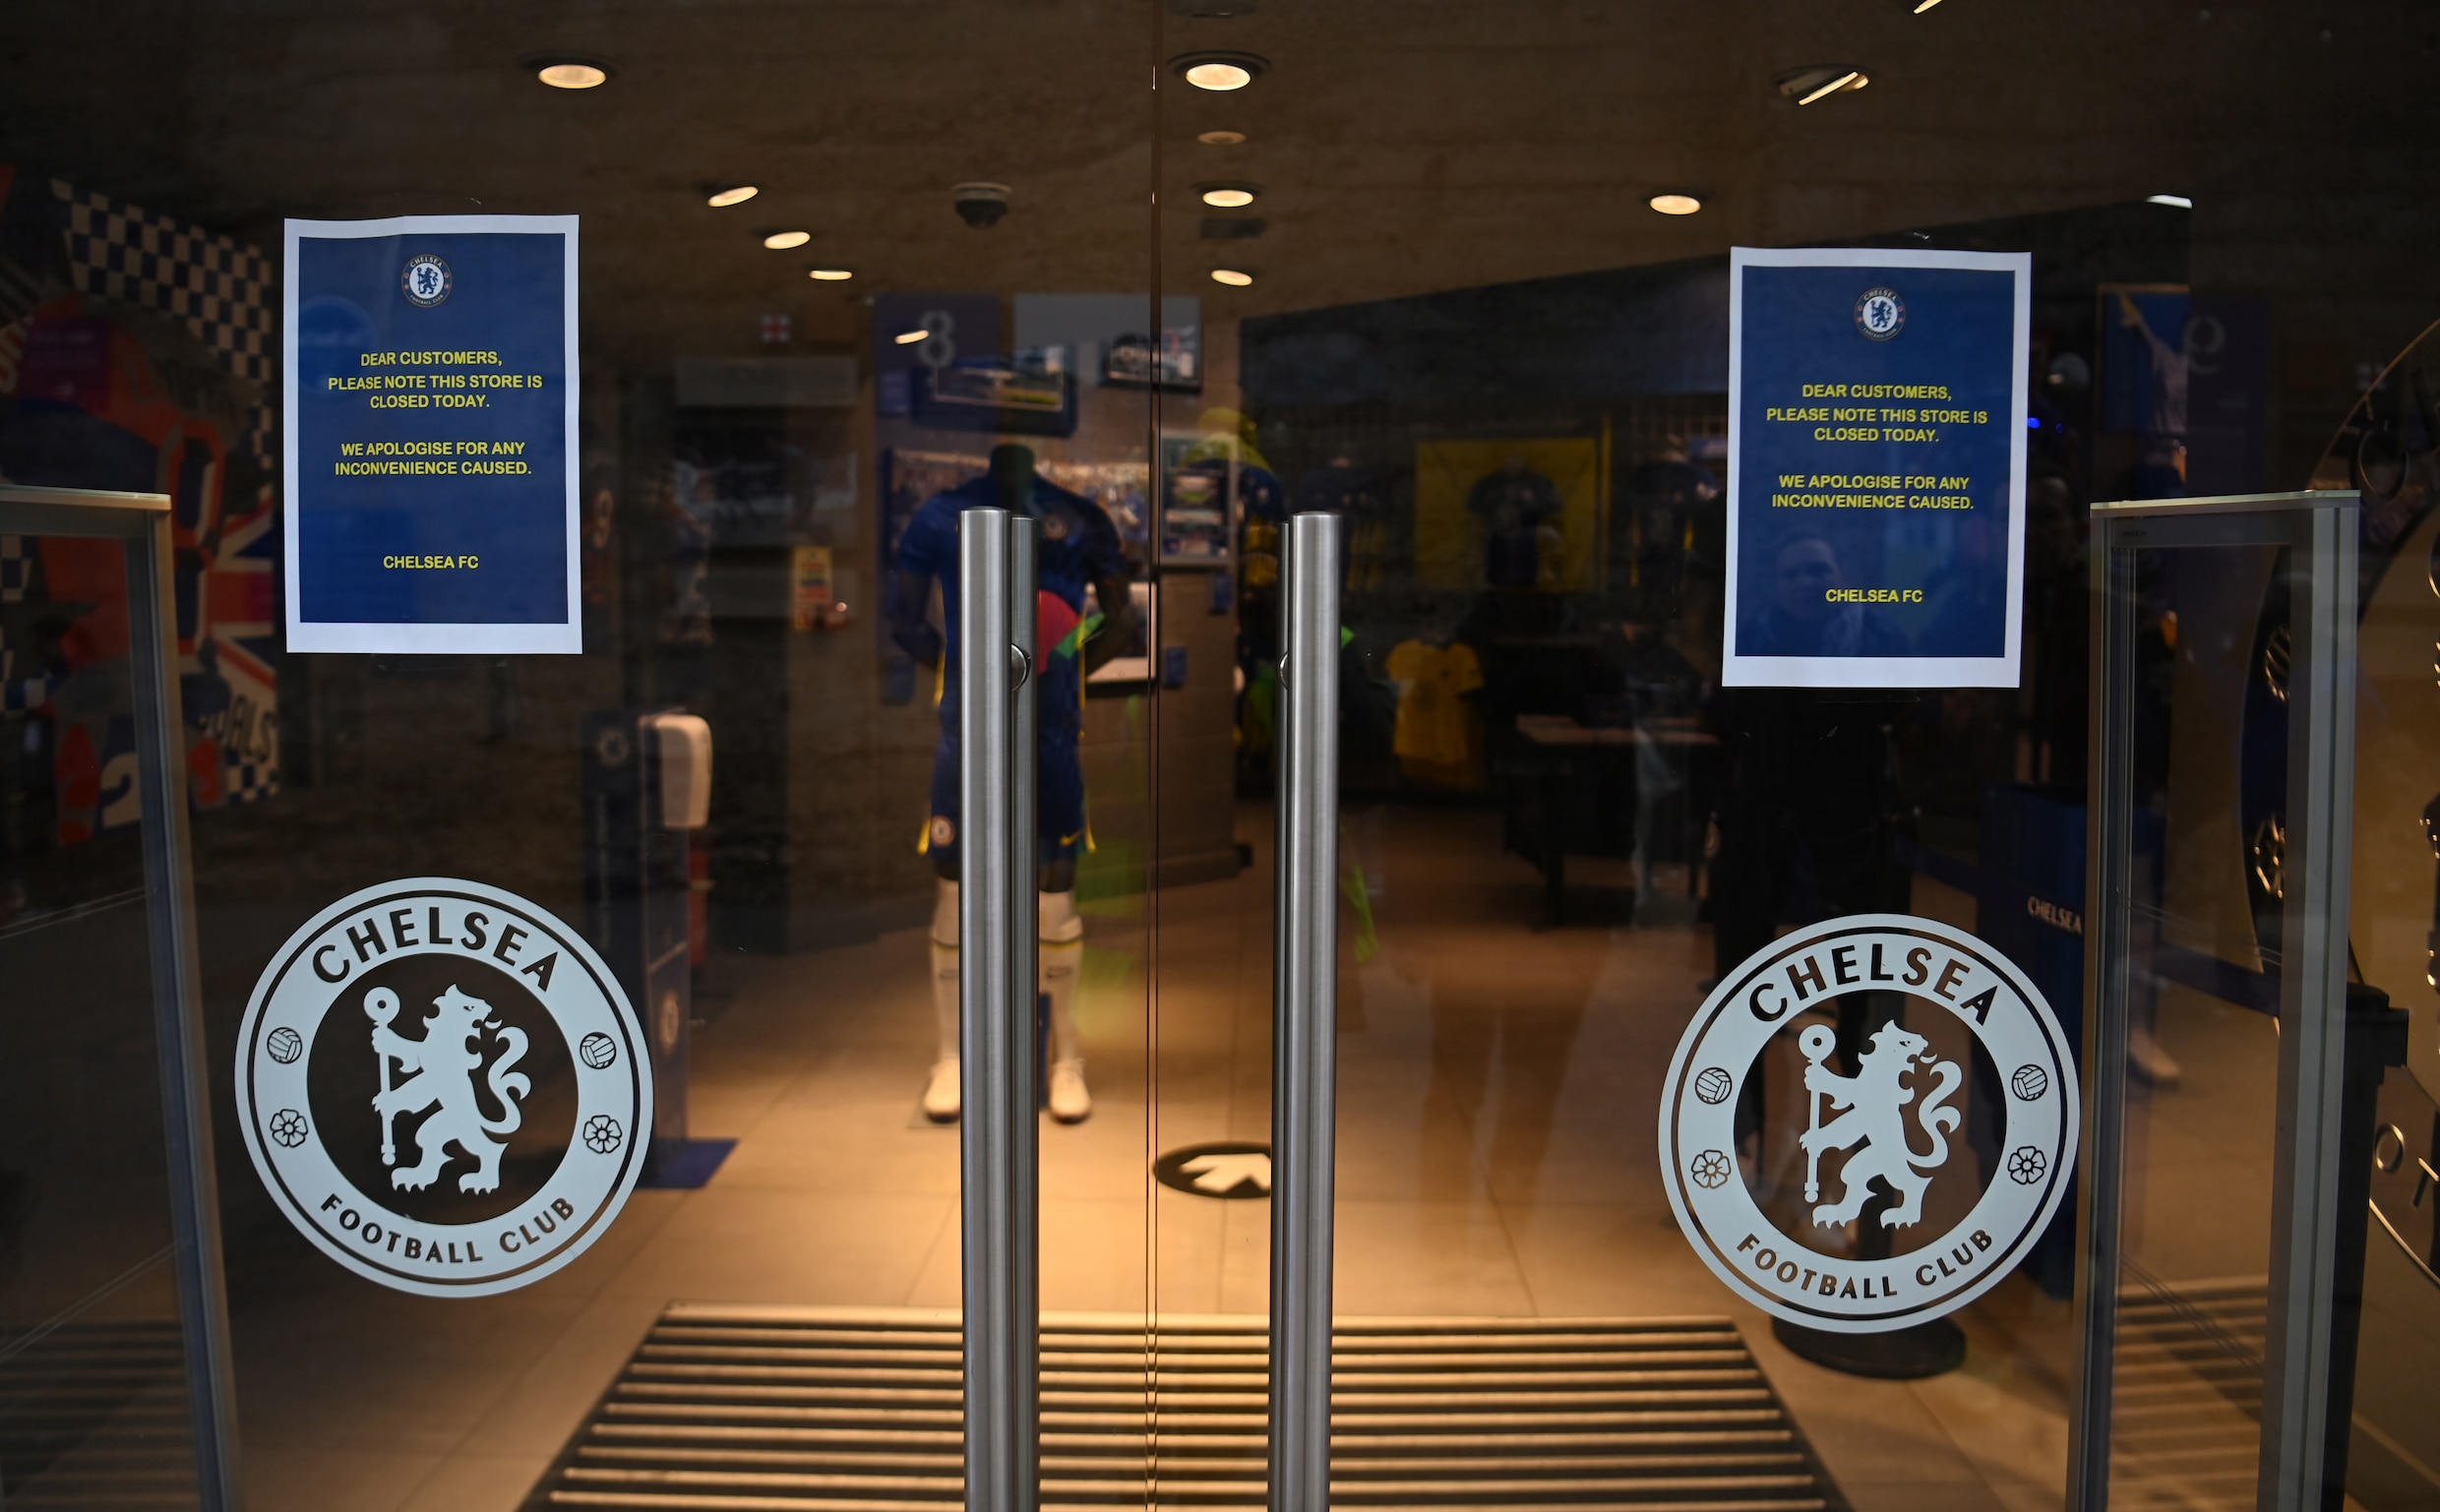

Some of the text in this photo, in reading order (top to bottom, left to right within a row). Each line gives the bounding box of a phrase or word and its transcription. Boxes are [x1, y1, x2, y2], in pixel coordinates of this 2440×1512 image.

[410, 256, 443, 268] CHELSEA
[1863, 289, 1897, 302] CHELSEA
[360, 350, 503, 366] DEAR CUSTOMERS,
[328, 375, 543, 391] PLEASE NOTE THIS STORE IS
[1802, 384, 1952, 401] DEAR CUSTOMERS,
[370, 393, 490, 409] CLOSED TODAY.
[1766, 408, 1987, 424] PLEASE NOTE THIS STORE IS
[1814, 427, 1939, 443] CLOSED TODAY.
[341, 442, 525, 456] WE APOLOGISE FOR ANY
[335, 460, 532, 476] INCONVENIENCE CAUSED.
[1779, 474, 1970, 490] WE APOLOGISE FOR ANY
[1771, 494, 1975, 510] INCONVENIENCE CAUSED.
[384, 555, 478, 569] CHELSEA FC
[1825, 588, 1923, 602] CHELSEA FC
[2028, 896, 2083, 937] CHELSEA
[313, 907, 559, 993] CHELSEA
[1749, 943, 1998, 1026] CHELSEA
[320, 1193, 575, 1263] FOOTBALL CLUB
[1737, 1229, 1992, 1299] FOOTBALL CLUB
